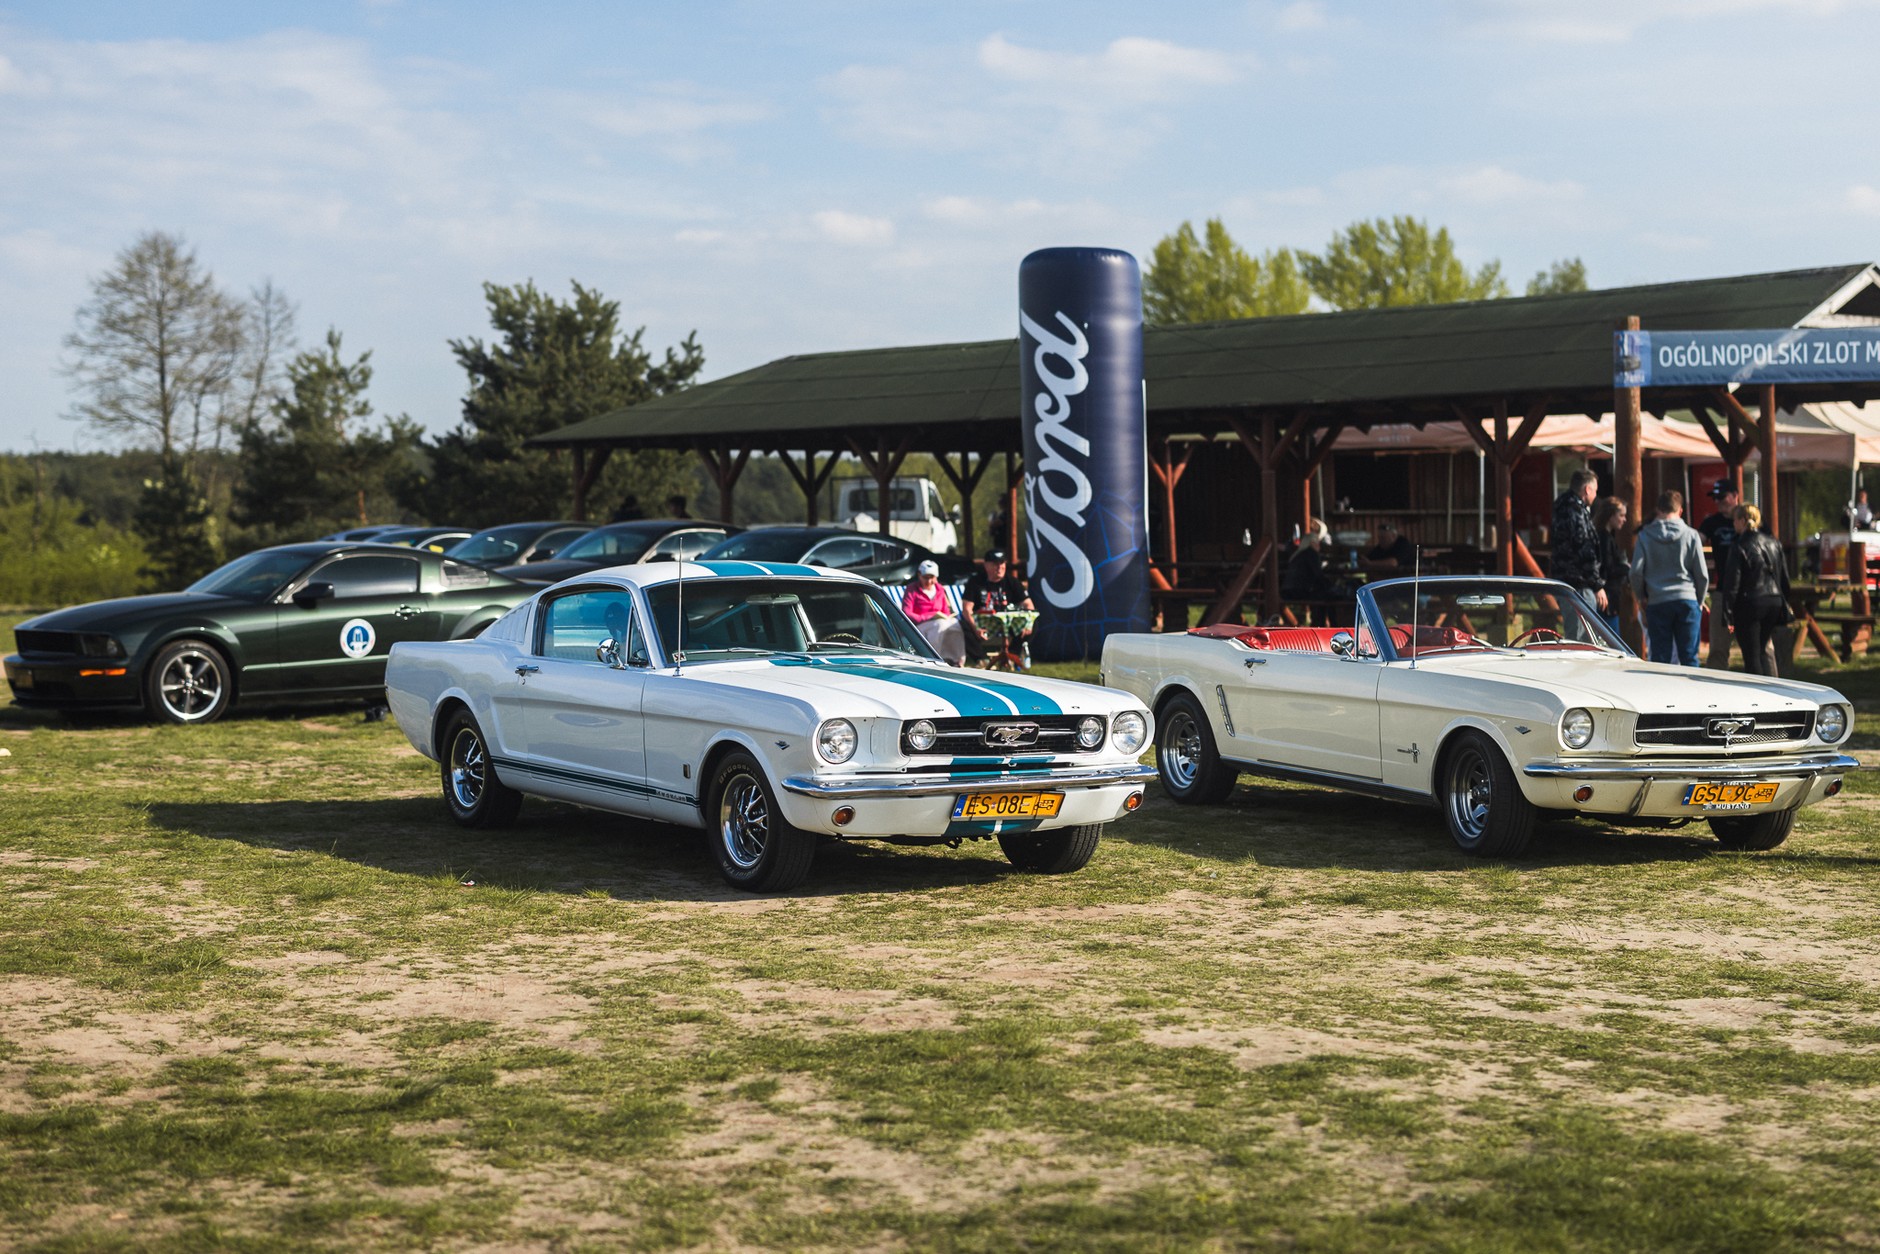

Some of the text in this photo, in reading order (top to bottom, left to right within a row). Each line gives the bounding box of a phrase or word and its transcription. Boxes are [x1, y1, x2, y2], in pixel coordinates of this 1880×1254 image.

[1659, 340, 1808, 367] OGÓLNOPOLSKI
[1813, 341, 1861, 364] ZLOT
[1021, 310, 1094, 609] Ford
[966, 796, 992, 814] ES
[1694, 786, 1726, 802] GSL
